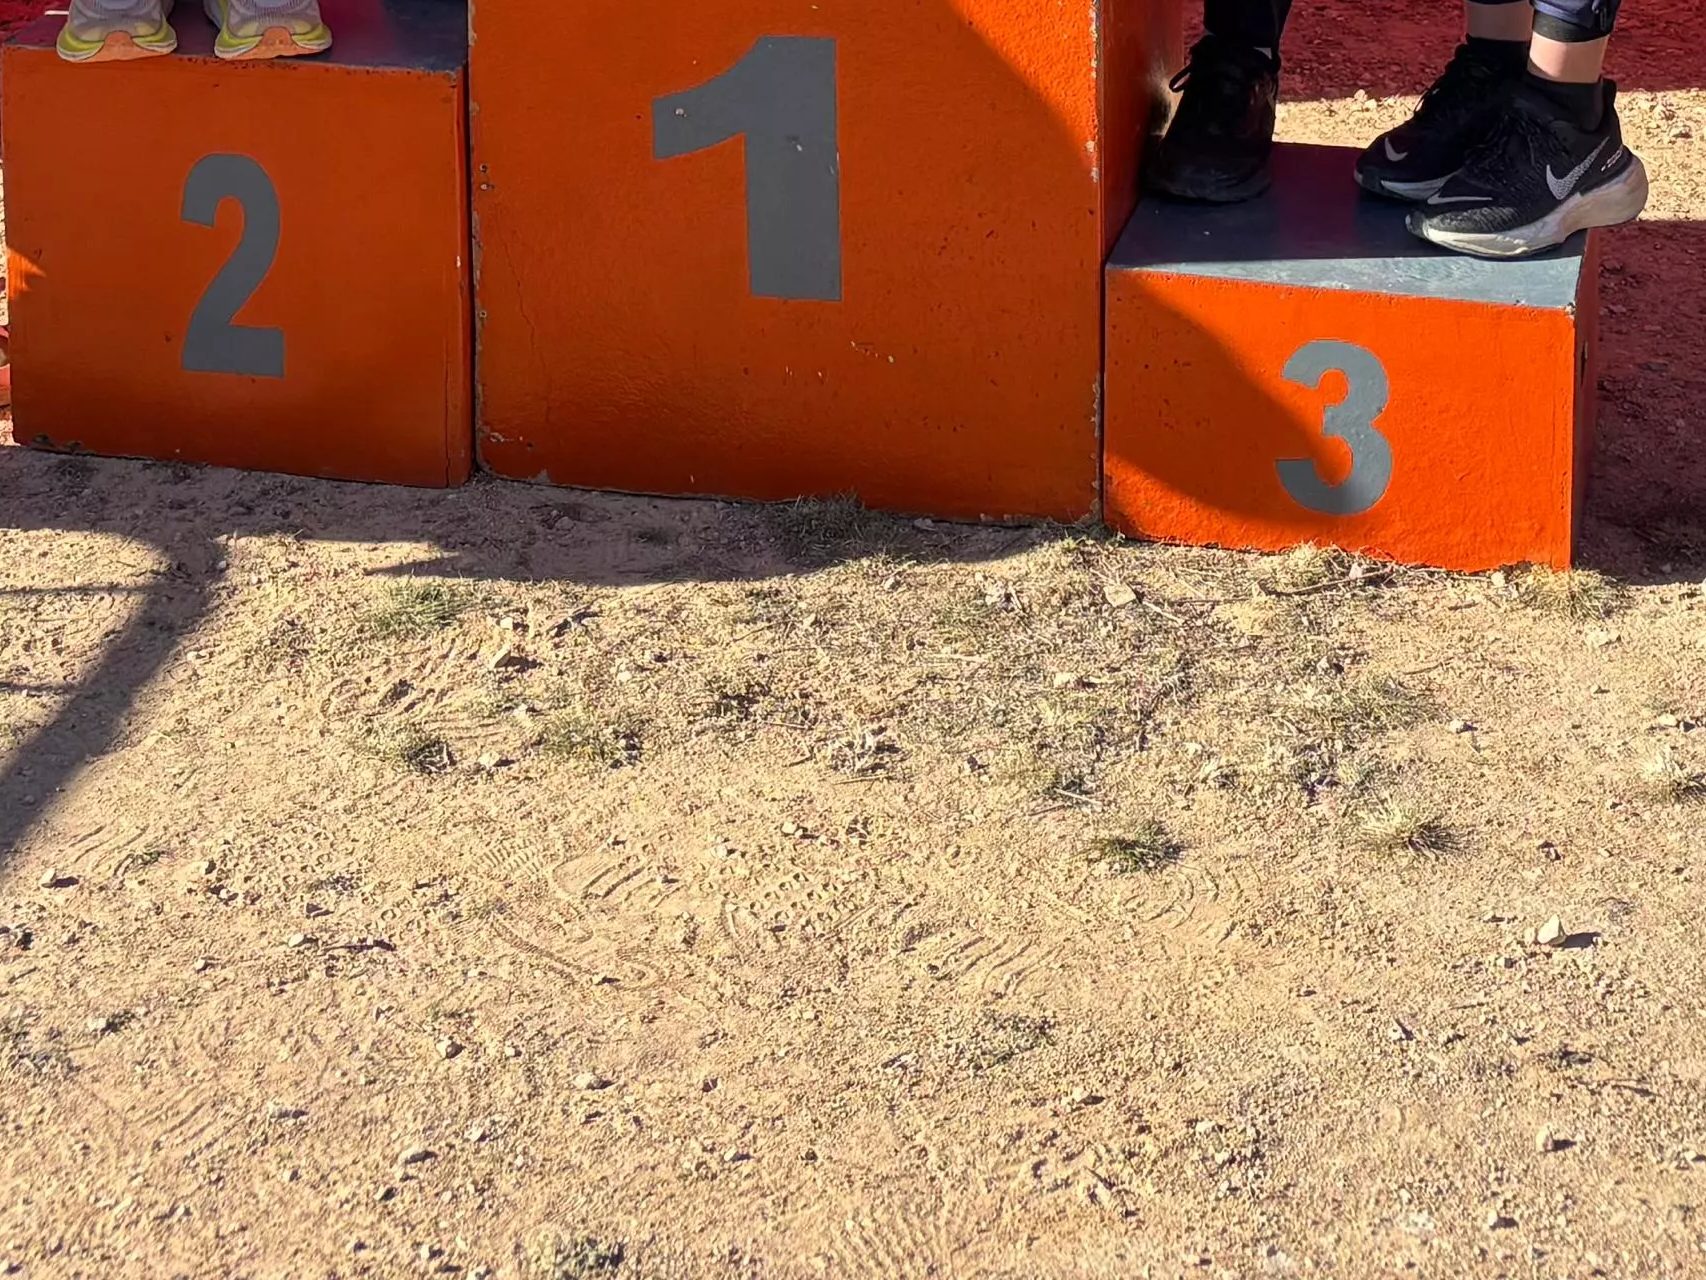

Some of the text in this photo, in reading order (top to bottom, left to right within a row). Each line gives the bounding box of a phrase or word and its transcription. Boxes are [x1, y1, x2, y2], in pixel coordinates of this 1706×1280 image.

[178, 151, 286, 379] 2
[651, 34, 844, 302] 1
[1274, 337, 1392, 516] 3
